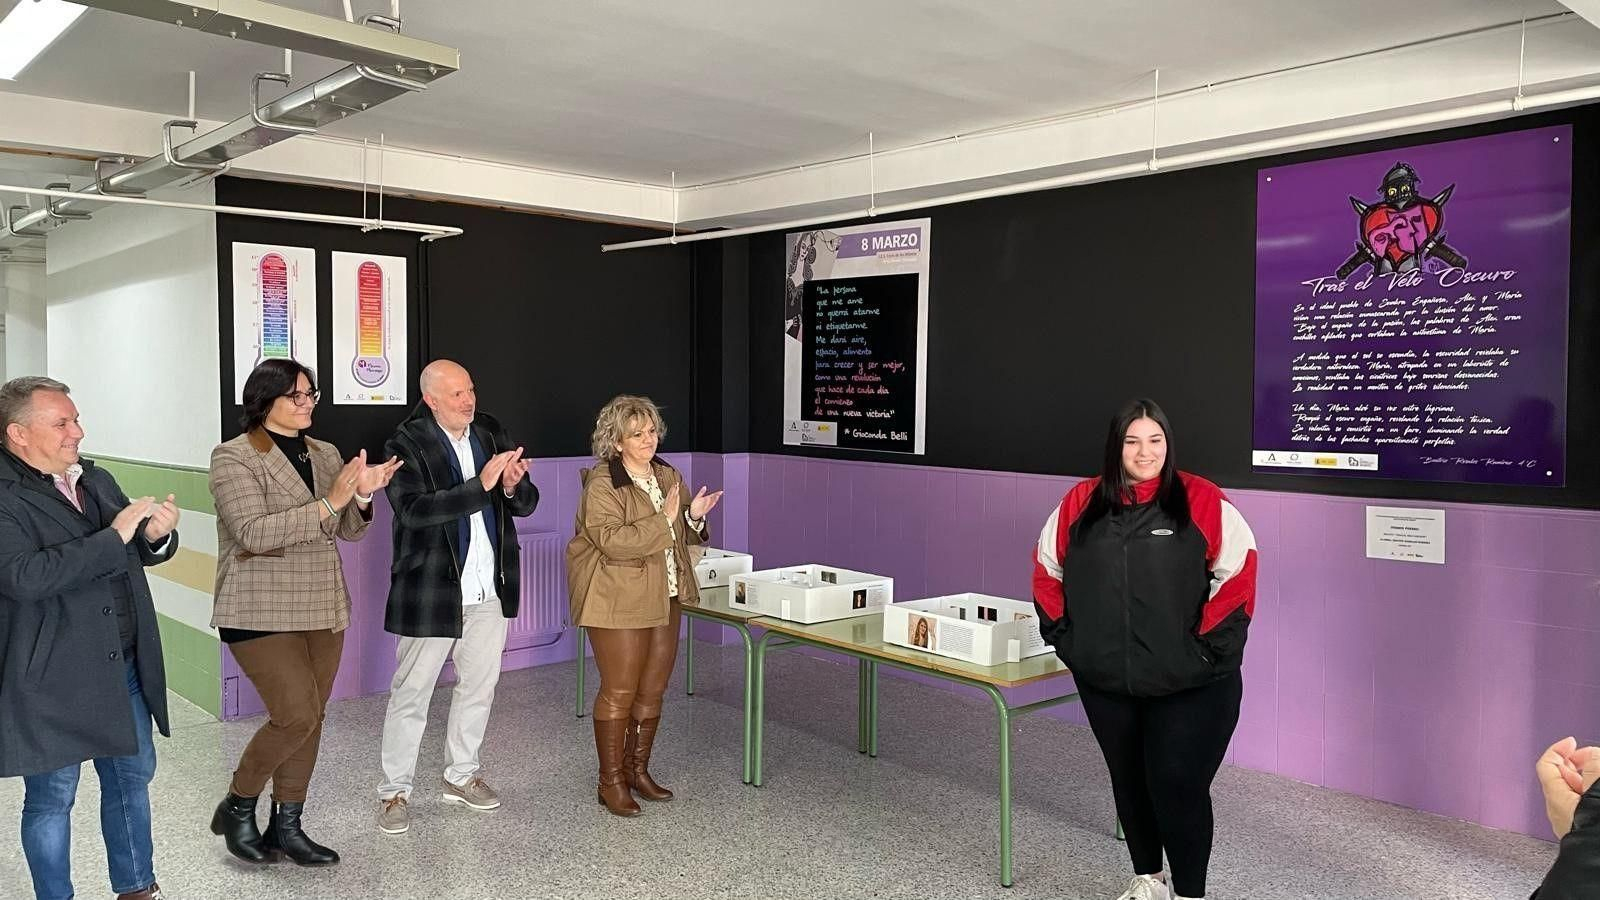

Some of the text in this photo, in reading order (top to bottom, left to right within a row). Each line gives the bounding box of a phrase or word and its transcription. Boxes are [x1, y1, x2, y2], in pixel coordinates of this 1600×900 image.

[861, 233, 918, 251] 8 MARZO
[1301, 267, 1518, 297] Tras el Velo Oscuro
[833, 286, 857, 296] persona
[816, 299, 828, 310] que
[1294, 304, 1304, 313] En
[1364, 300, 1372, 308] de
[1482, 295, 1488, 304] y
[1495, 290, 1522, 300] María
[854, 308, 880, 316] atarme
[1403, 310, 1416, 318] por
[1421, 307, 1429, 315] la
[1462, 304, 1474, 312] del
[816, 322, 822, 330] ni
[1321, 322, 1327, 330] el
[1358, 320, 1367, 328] de
[1410, 318, 1421, 326] las
[1424, 316, 1455, 328] palabras
[1460, 315, 1470, 323] de
[816, 334, 867, 346] Me dará aire,
[1321, 332, 1346, 342] afilados
[1351, 333, 1362, 342] que
[1453, 326, 1462, 334] de
[816, 346, 872, 358] espacio, alimento
[1292, 352, 1306, 363] A
[1308, 352, 1330, 360] medida
[1334, 354, 1346, 362] que
[1422, 349, 1430, 357] la
[1436, 348, 1472, 356] oscuridad
[816, 360, 830, 370] para
[858, 362, 863, 375] y
[883, 360, 906, 373] mejor,
[1292, 362, 1322, 370] verdadera
[1398, 360, 1428, 372] atrapada
[1463, 358, 1494, 368] laberinto
[1499, 358, 1510, 366] de
[1354, 372, 1364, 380] las
[1369, 372, 1398, 380] cicatrices
[1402, 372, 1418, 382] bajo
[1422, 372, 1448, 380] sonrisas
[815, 386, 826, 398] que
[829, 385, 844, 393] hace
[846, 384, 855, 394] de
[857, 385, 875, 394] cada
[1292, 382, 1303, 393] La
[1307, 382, 1334, 391] realidad
[1394, 382, 1404, 390] de
[1408, 384, 1428, 393] gritos
[815, 397, 854, 406] el comienzo
[1292, 403, 1305, 412] Un
[1326, 404, 1350, 412] María
[1402, 404, 1420, 412] entre
[815, 406, 823, 416] de
[1389, 414, 1420, 422] revelando
[1425, 414, 1432, 422] la
[853, 429, 908, 441] Gioconda Belli
[1469, 426, 1477, 434] la
[1483, 426, 1511, 435] verdad
[1314, 434, 1322, 442] de
[1327, 434, 1336, 442] las
[1340, 434, 1370, 445] fachadas
